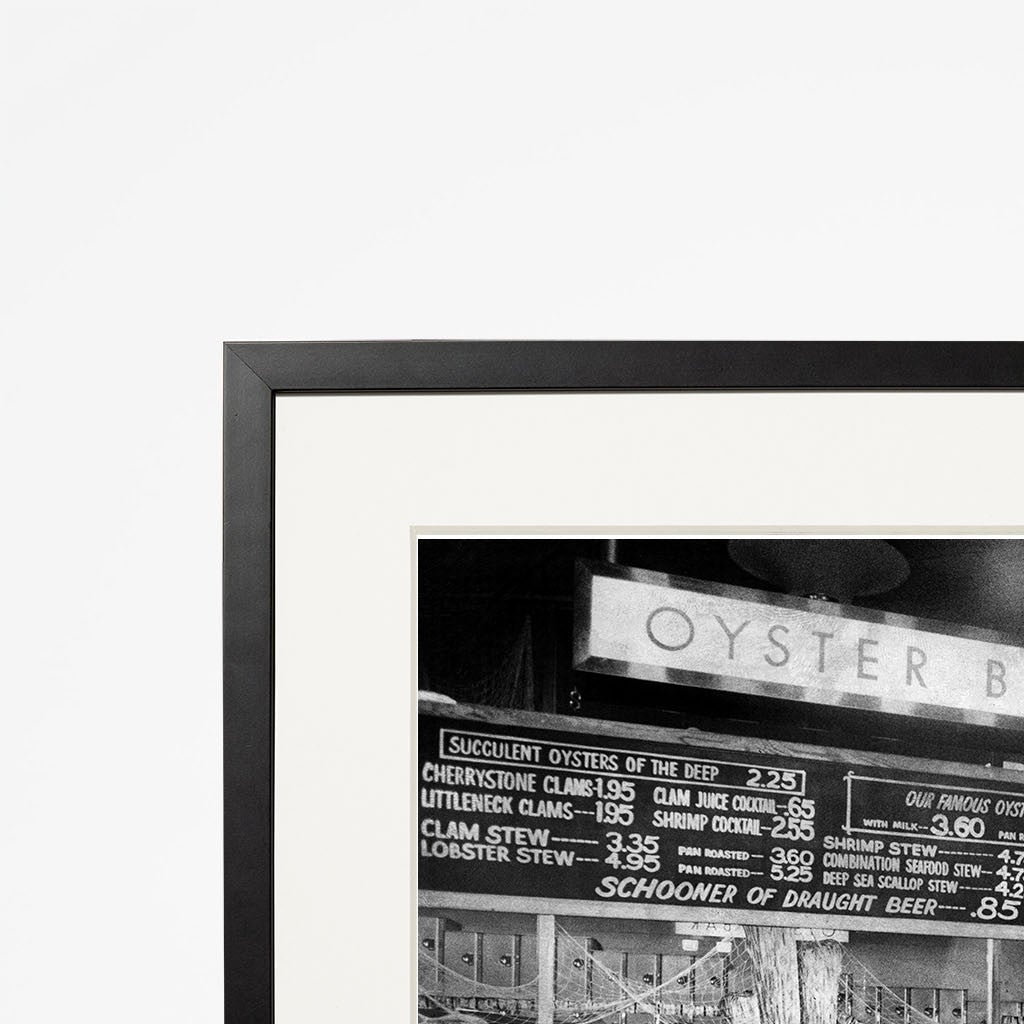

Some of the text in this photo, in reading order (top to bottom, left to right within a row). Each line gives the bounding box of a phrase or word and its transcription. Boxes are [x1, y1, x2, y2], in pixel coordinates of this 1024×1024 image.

[645, 606, 929, 690] OYSTER
[448, 736, 797, 790] SUCCULENT OYSTERS OF THE DEEP 2.25
[421, 762, 635, 802] CHERRYSTONE CLAMS 1.95
[421, 787, 514, 814] LITTLENECK
[518, 798, 575, 820] CLAMS
[653, 786, 815, 820] CLAM JUICE COCKTAIL .65
[905, 790, 935, 809] OUR
[937, 793, 992, 815] FAMOUS
[420, 818, 660, 854] CLAM STEW 3.35
[652, 810, 709, 831] SHRIMP
[712, 815, 763, 836] COCKTAIL
[863, 813, 986, 838] WITH MILK 3.60
[998, 830, 1017, 841] PAN
[420, 839, 660, 873] LOBSTER STEW 4.95
[678, 846, 702, 857] PAN
[704, 848, 750, 861] ROASTED
[823, 835, 885, 853] SHRIMP
[888, 841, 938, 857] STEW
[678, 863, 813, 883] PAN ROASTED 5.25
[823, 852, 900, 873] COMBINATION
[905, 858, 949, 876] SEAFOOD
[953, 863, 982, 878] STEW
[823, 871, 850, 887] DEEP
[853, 873, 875, 888] SEA
[877, 875, 924, 891] SCALLOP
[928, 879, 959, 894] STEW
[595, 875, 1022, 920] SCHOONER OF DRAUGHT BEER .85
